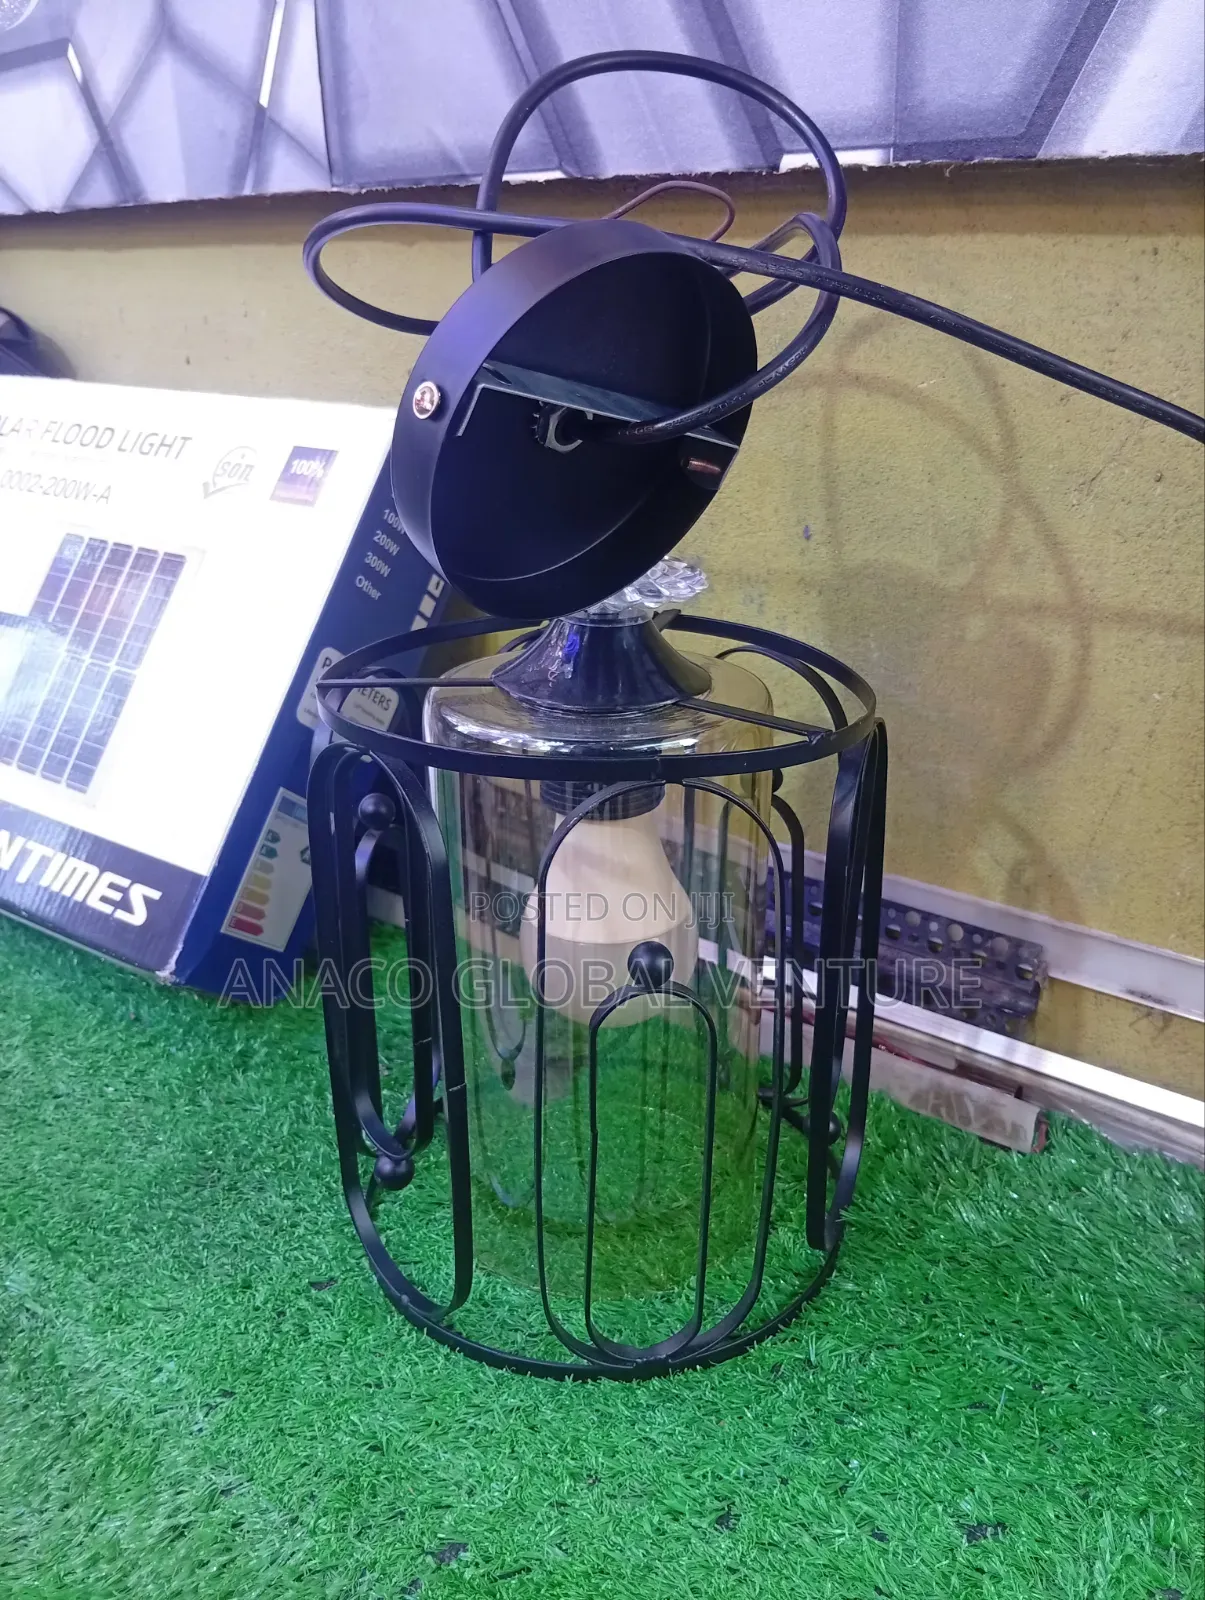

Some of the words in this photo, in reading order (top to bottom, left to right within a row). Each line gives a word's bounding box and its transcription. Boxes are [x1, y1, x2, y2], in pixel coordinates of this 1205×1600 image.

[0, 415, 39, 439] LAR
[40, 420, 115, 450] FLOOD
[117, 430, 192, 460] LIGHT
[290, 458, 326, 478] 100%
[373, 530, 400, 556] 200W
[365, 552, 391, 577] 300W
[355, 575, 382, 600] Other
